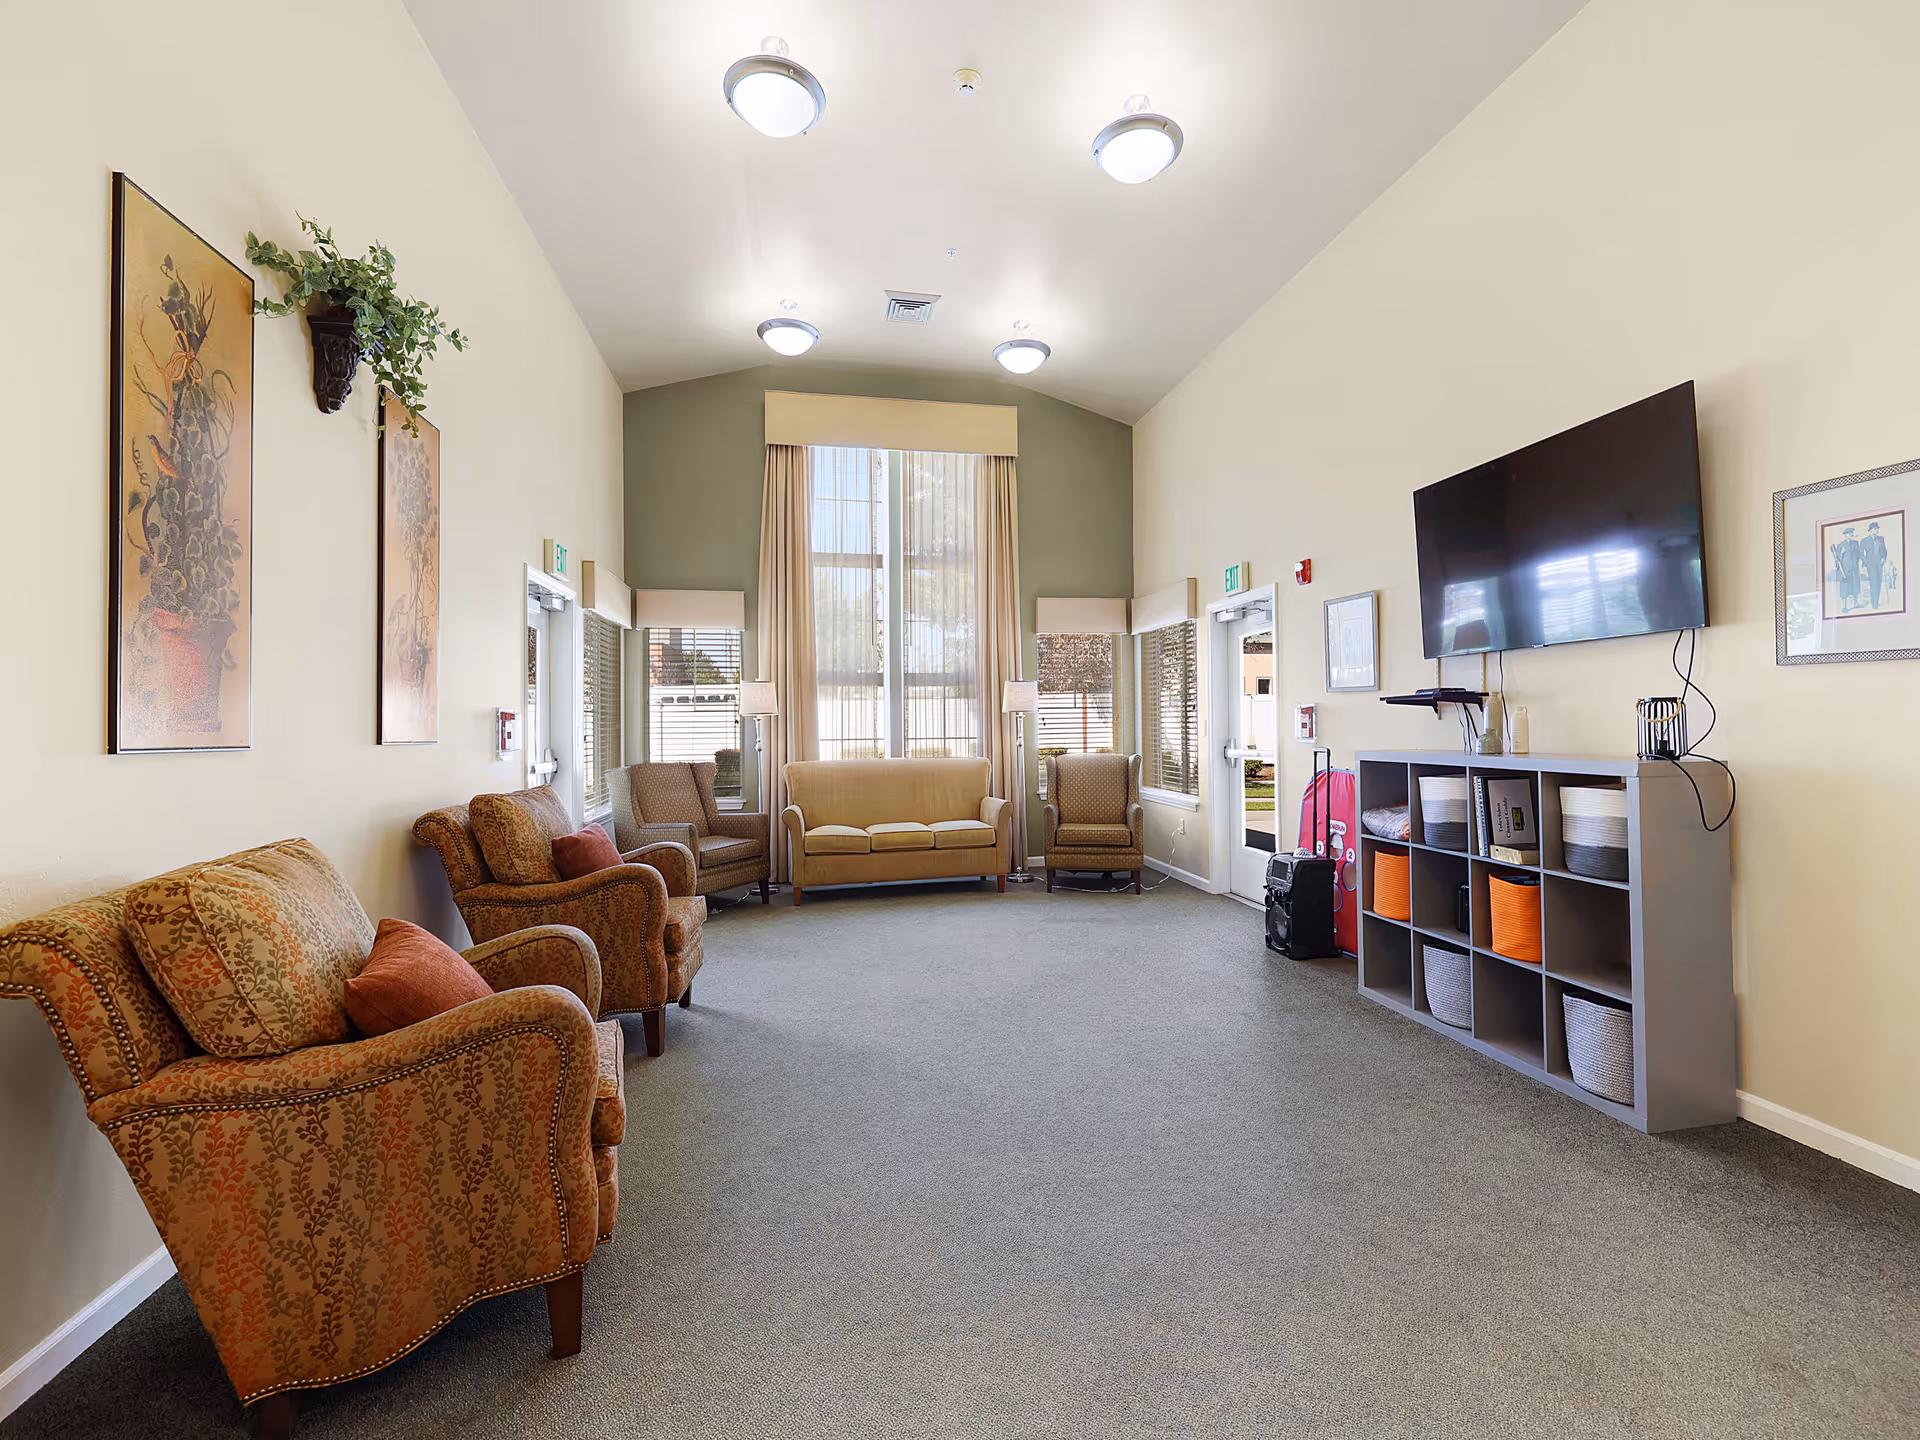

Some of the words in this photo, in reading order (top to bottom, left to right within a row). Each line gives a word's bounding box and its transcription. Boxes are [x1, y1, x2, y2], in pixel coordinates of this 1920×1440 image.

[557, 544, 567, 575] EXIT
[1225, 565, 1239, 592] EXIT
[1330, 822, 1344, 831] OMERUN
